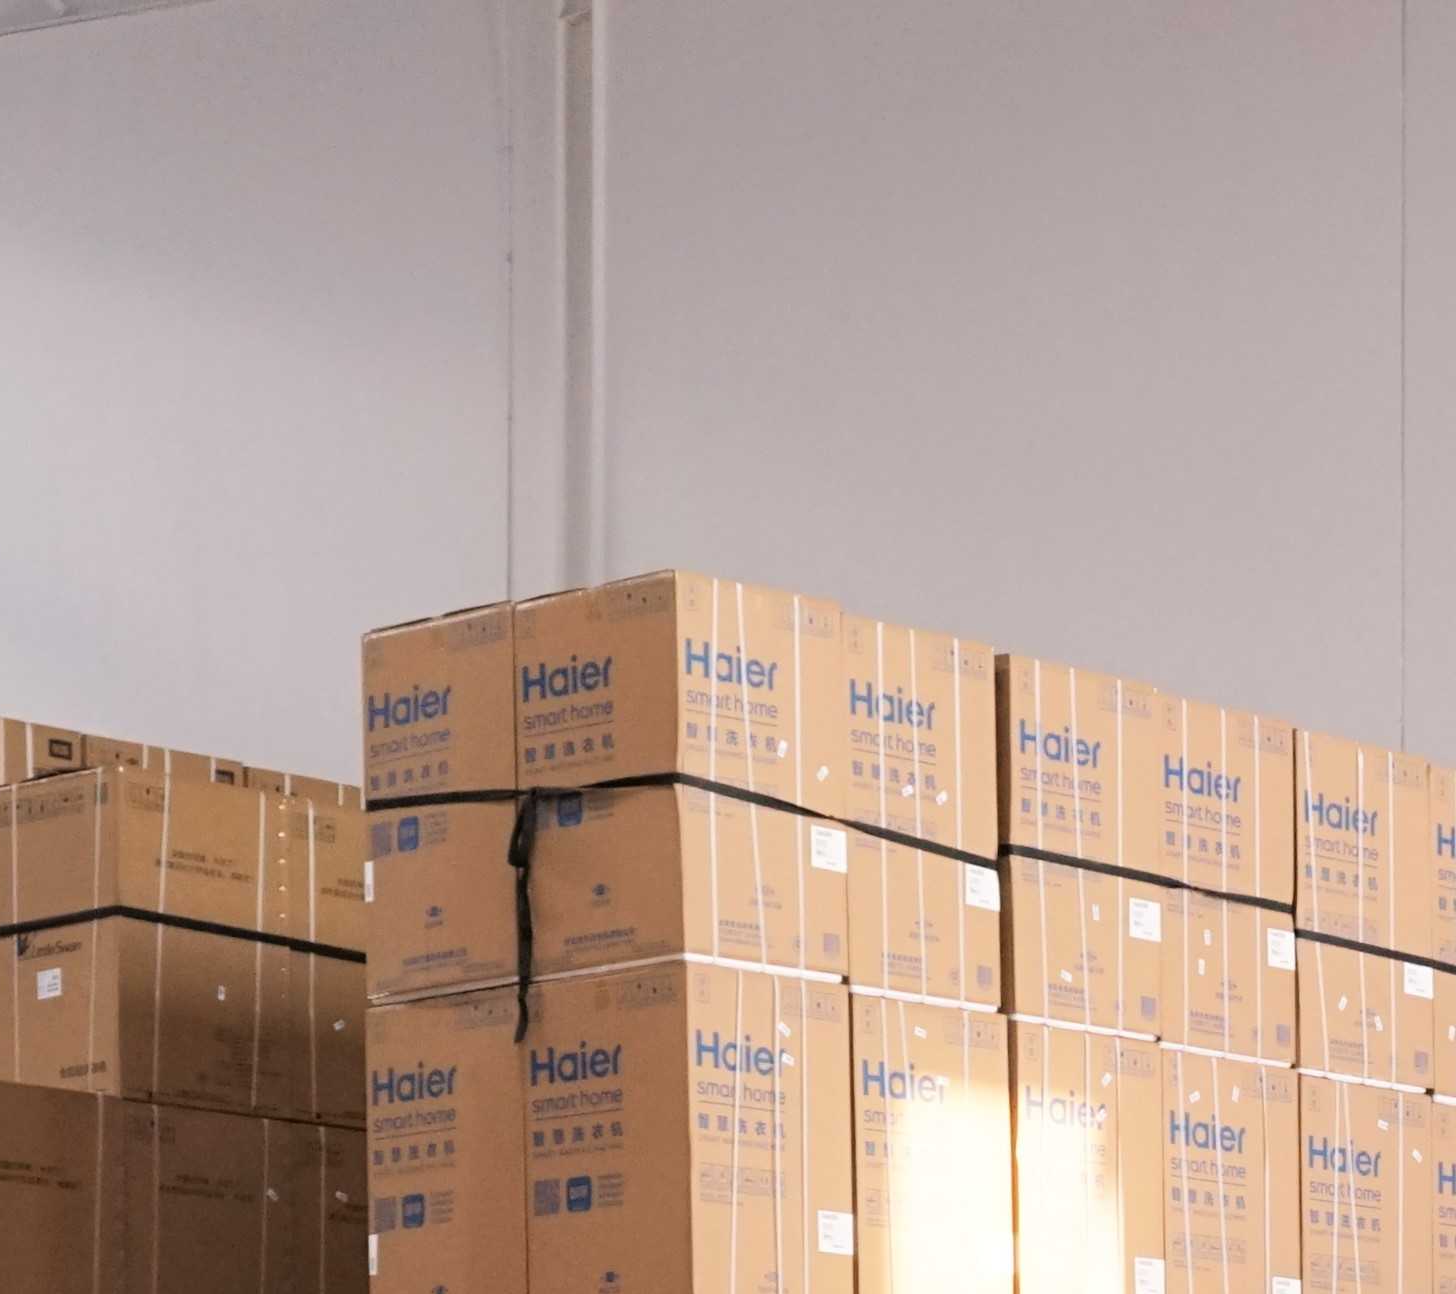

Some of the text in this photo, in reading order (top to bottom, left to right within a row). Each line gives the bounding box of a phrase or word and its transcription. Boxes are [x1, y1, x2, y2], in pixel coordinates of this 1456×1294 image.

[523, 655, 612, 702] Haier
[685, 638, 777, 690] Haier
[368, 685, 451, 731] Haier
[850, 679, 935, 730] Haier
[1020, 719, 1100, 768] Haier
[1164, 754, 1240, 802] Haier
[1305, 790, 1378, 836] Haier
[372, 1061, 457, 1105] Haier
[531, 1041, 621, 1086] Haier
[1170, 1110, 1246, 1153] Haier
[1308, 1136, 1381, 1178] Haier
